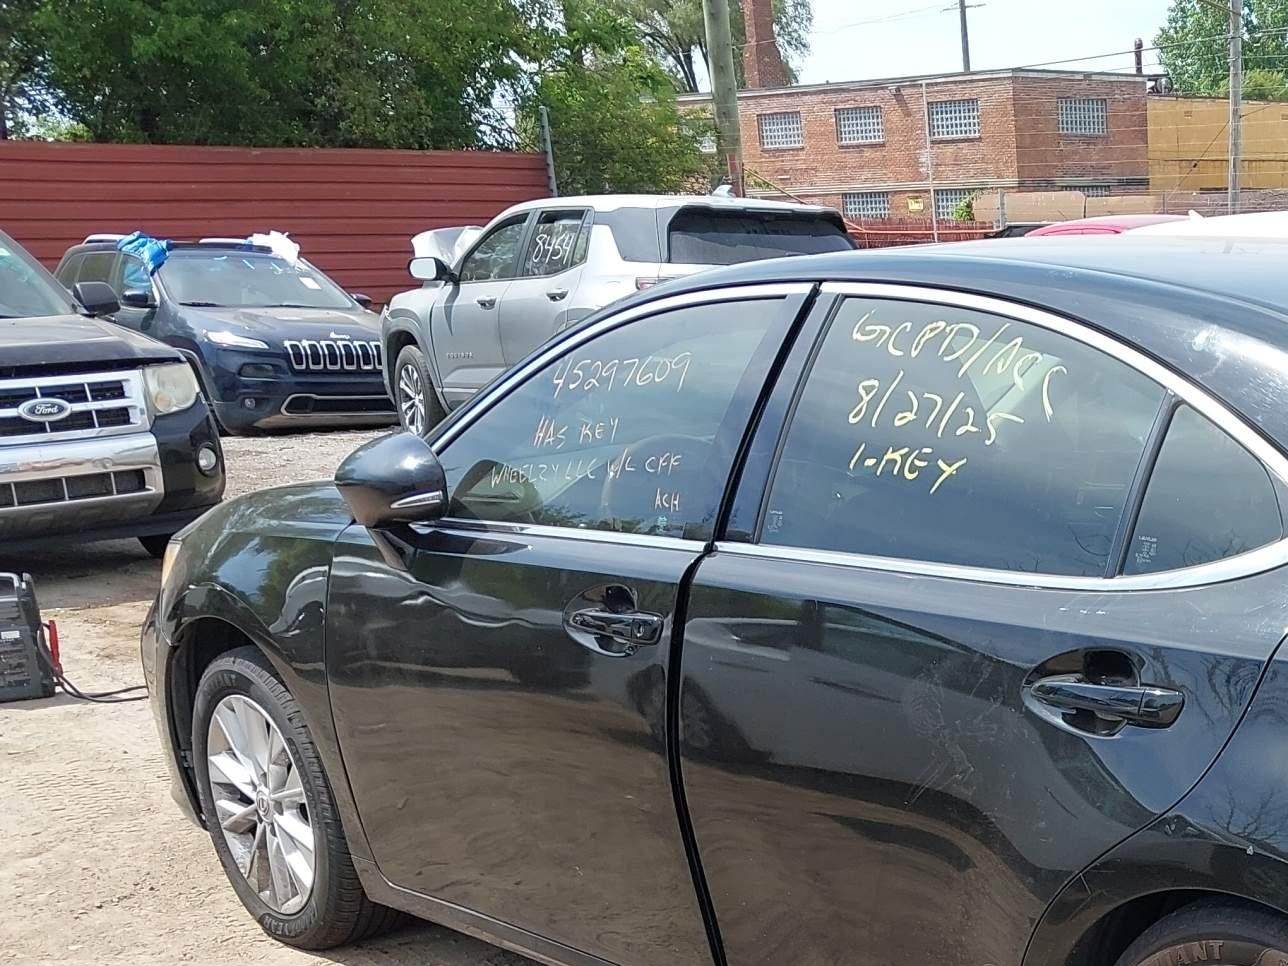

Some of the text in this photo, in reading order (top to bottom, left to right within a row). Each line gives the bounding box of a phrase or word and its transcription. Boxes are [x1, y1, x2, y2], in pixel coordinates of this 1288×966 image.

[533, 232, 574, 265] 8454
[552, 352, 692, 399] 45297609
[35, 404, 58, 414] Ford
[849, 370, 1025, 445] 8/27/25
[533, 416, 619, 449] HAS KEY
[565, 458, 596, 480] LLC
